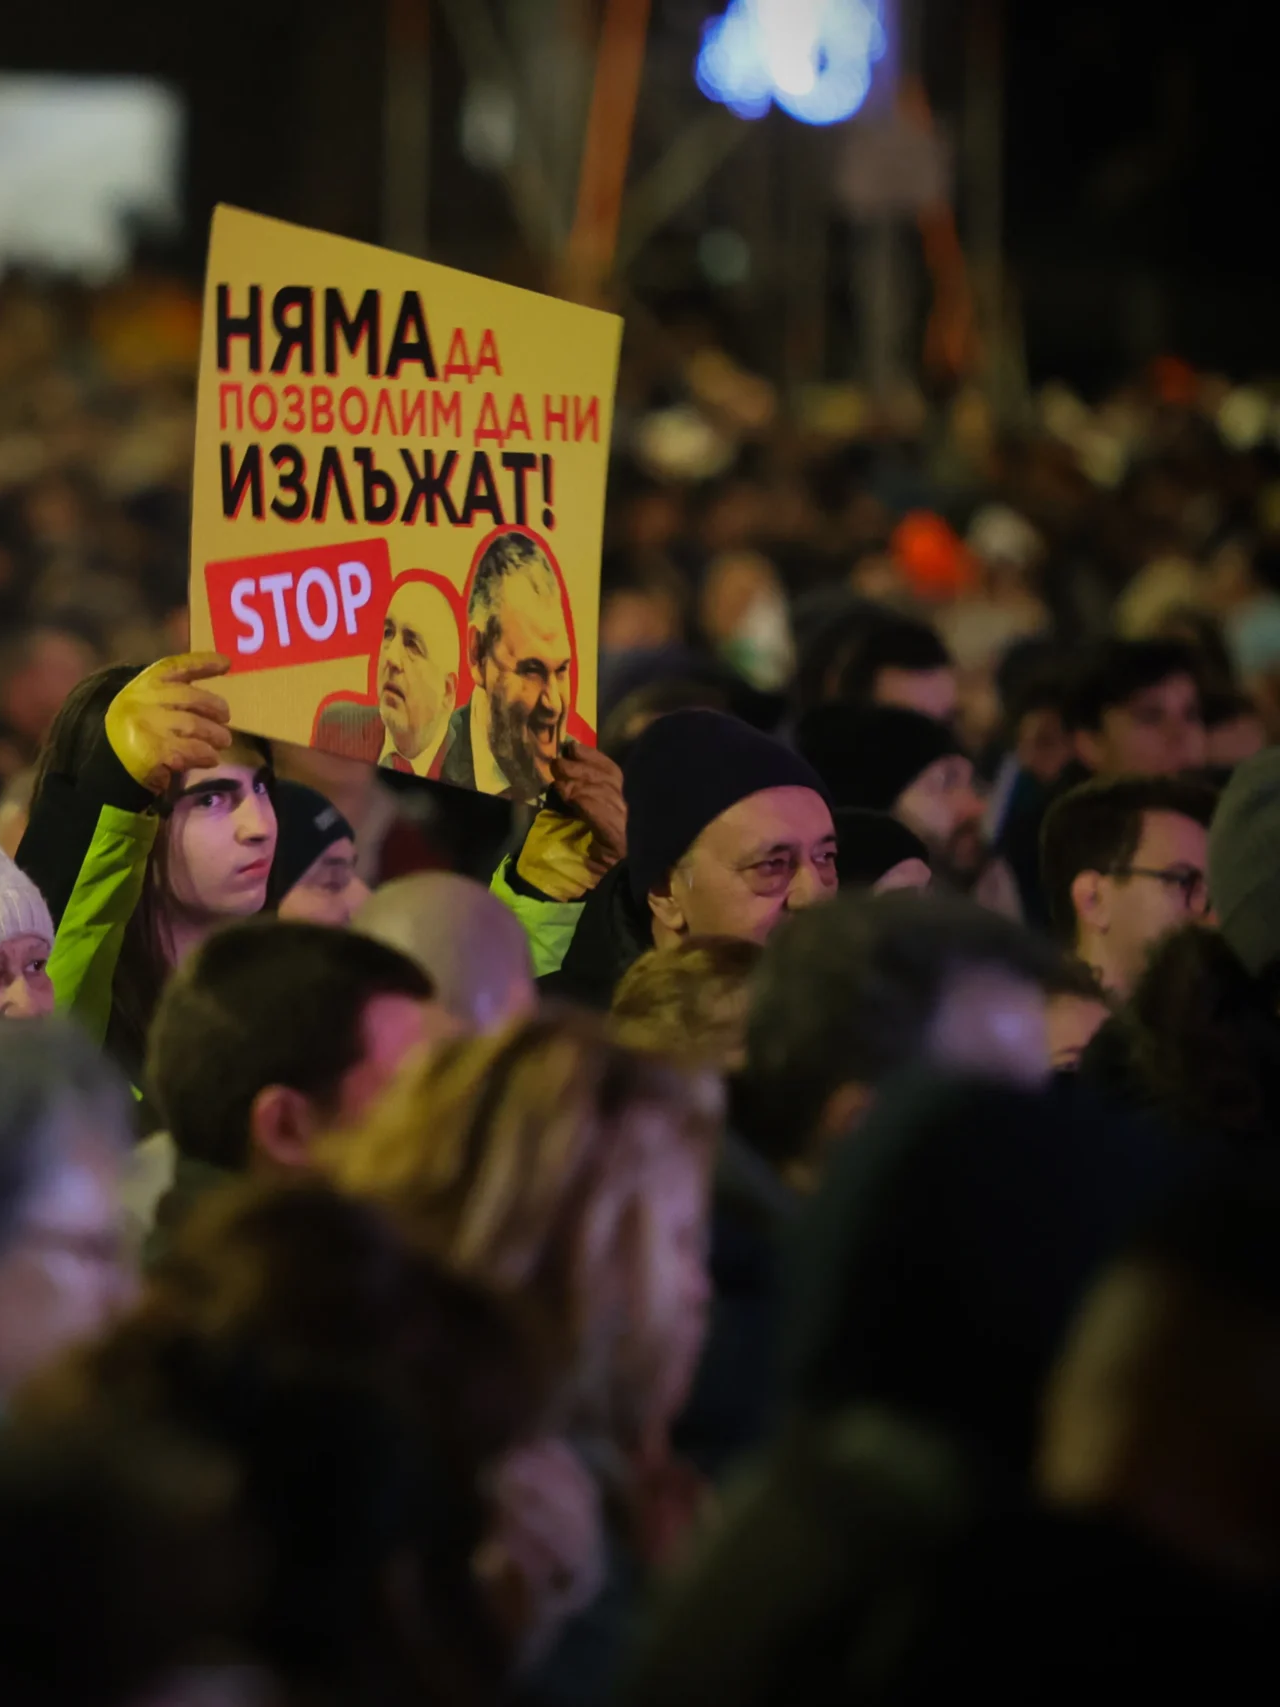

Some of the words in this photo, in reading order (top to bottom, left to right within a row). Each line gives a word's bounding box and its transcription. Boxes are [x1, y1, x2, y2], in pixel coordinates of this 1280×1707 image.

[216, 283, 439, 380] НЯМА
[444, 328, 503, 382] ДА
[219, 383, 462, 438] ПОЗВОЛИМ
[473, 393, 531, 447] ДА
[544, 395, 600, 442] НИ
[221, 443, 556, 530] ИЗЛЪЖАТ!
[230, 561, 373, 654] STOP
